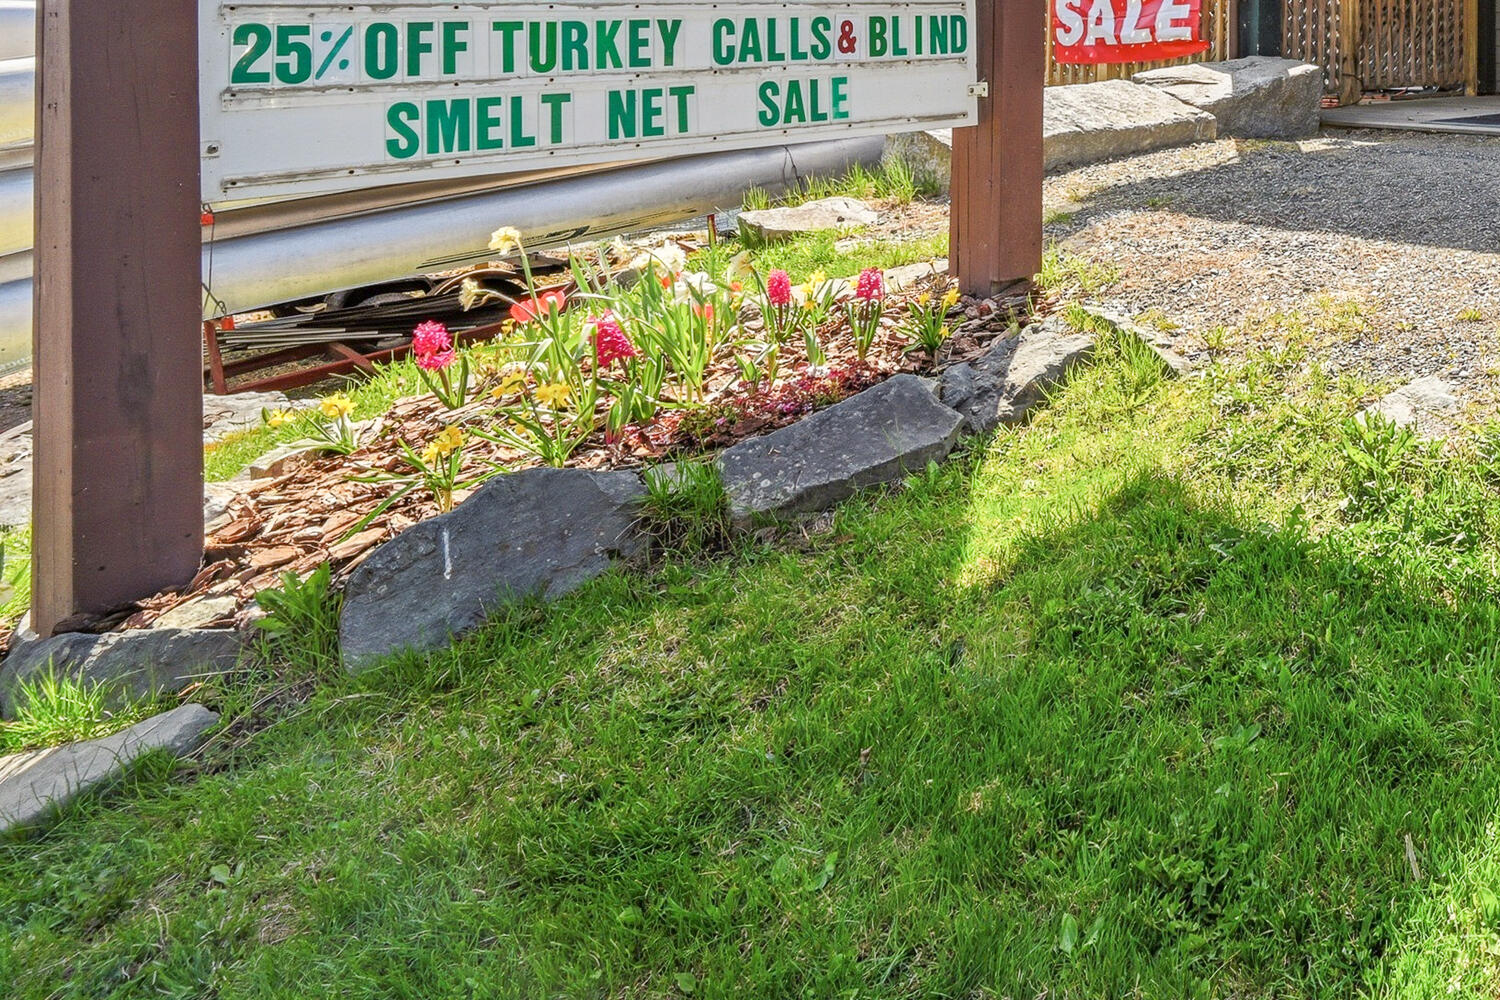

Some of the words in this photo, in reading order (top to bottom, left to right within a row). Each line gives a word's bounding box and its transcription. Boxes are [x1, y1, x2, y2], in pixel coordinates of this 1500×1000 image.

[231, 22, 354, 85] 25%
[364, 21, 469, 81] OFF
[492, 18, 682, 74] TURKEY
[712, 15, 832, 66] CALLS
[837, 19, 857, 54] &
[868, 14, 968, 58] BLIND
[386, 92, 572, 160] SMELT
[608, 85, 696, 140] NET
[758, 76, 850, 127] SALE
